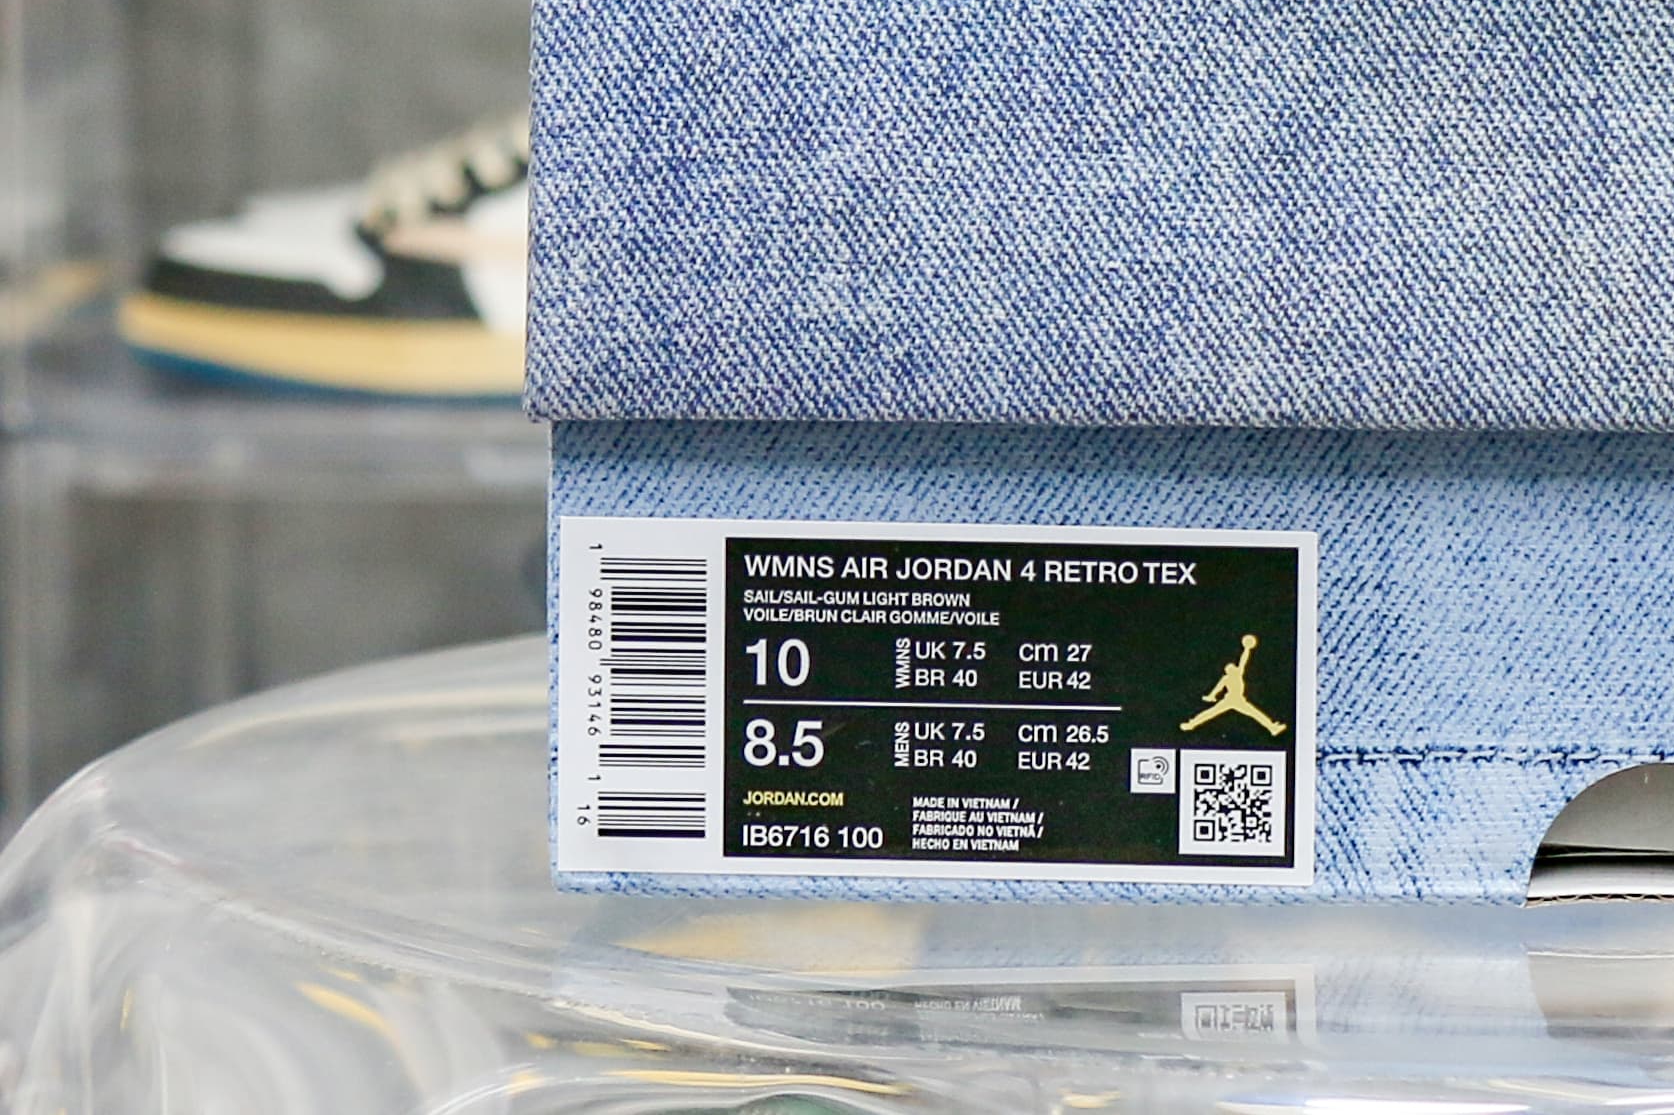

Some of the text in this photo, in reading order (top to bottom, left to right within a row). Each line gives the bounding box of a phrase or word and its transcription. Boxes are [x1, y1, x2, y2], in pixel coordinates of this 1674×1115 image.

[743, 555, 1198, 585] WMNS AIR JORDAN 4 RETRO TEX
[743, 589, 970, 608] SAIL/SAIL-GUM LIGHT BROWN
[588, 588, 603, 650] 98480
[743, 607, 1000, 626] VOILE/BRUN CLAIR GOMME/VOILE
[915, 642, 986, 661] UK 7.5
[1067, 644, 1092, 663] 27
[745, 638, 811, 686] 10
[896, 637, 911, 689] WMNS
[915, 669, 978, 688] BR 40
[1019, 672, 1092, 691] EUR 42
[587, 674, 602, 736] 93146
[915, 723, 985, 742] UK 7.5
[1066, 725, 1109, 745] 26.5
[743, 718, 825, 768] 8.5
[895, 721, 910, 768] MENS
[914, 750, 977, 769] BR 40
[1018, 752, 1091, 772] EUR 42
[743, 790, 844, 807] JORDAN.COM
[913, 796, 945, 809] MADE
[947, 797, 960, 809] IN
[962, 797, 1010, 810] VIETNAM
[576, 805, 591, 825] 16
[913, 810, 967, 824] FABRIQUE
[968, 811, 984, 823] AU
[987, 811, 1035, 824] VIETNAM
[741, 825, 884, 849] IB6716 100
[913, 824, 974, 837] FABRICADO
[977, 825, 994, 837] NO
[912, 838, 1020, 852] HECHO EN VIETNAM
